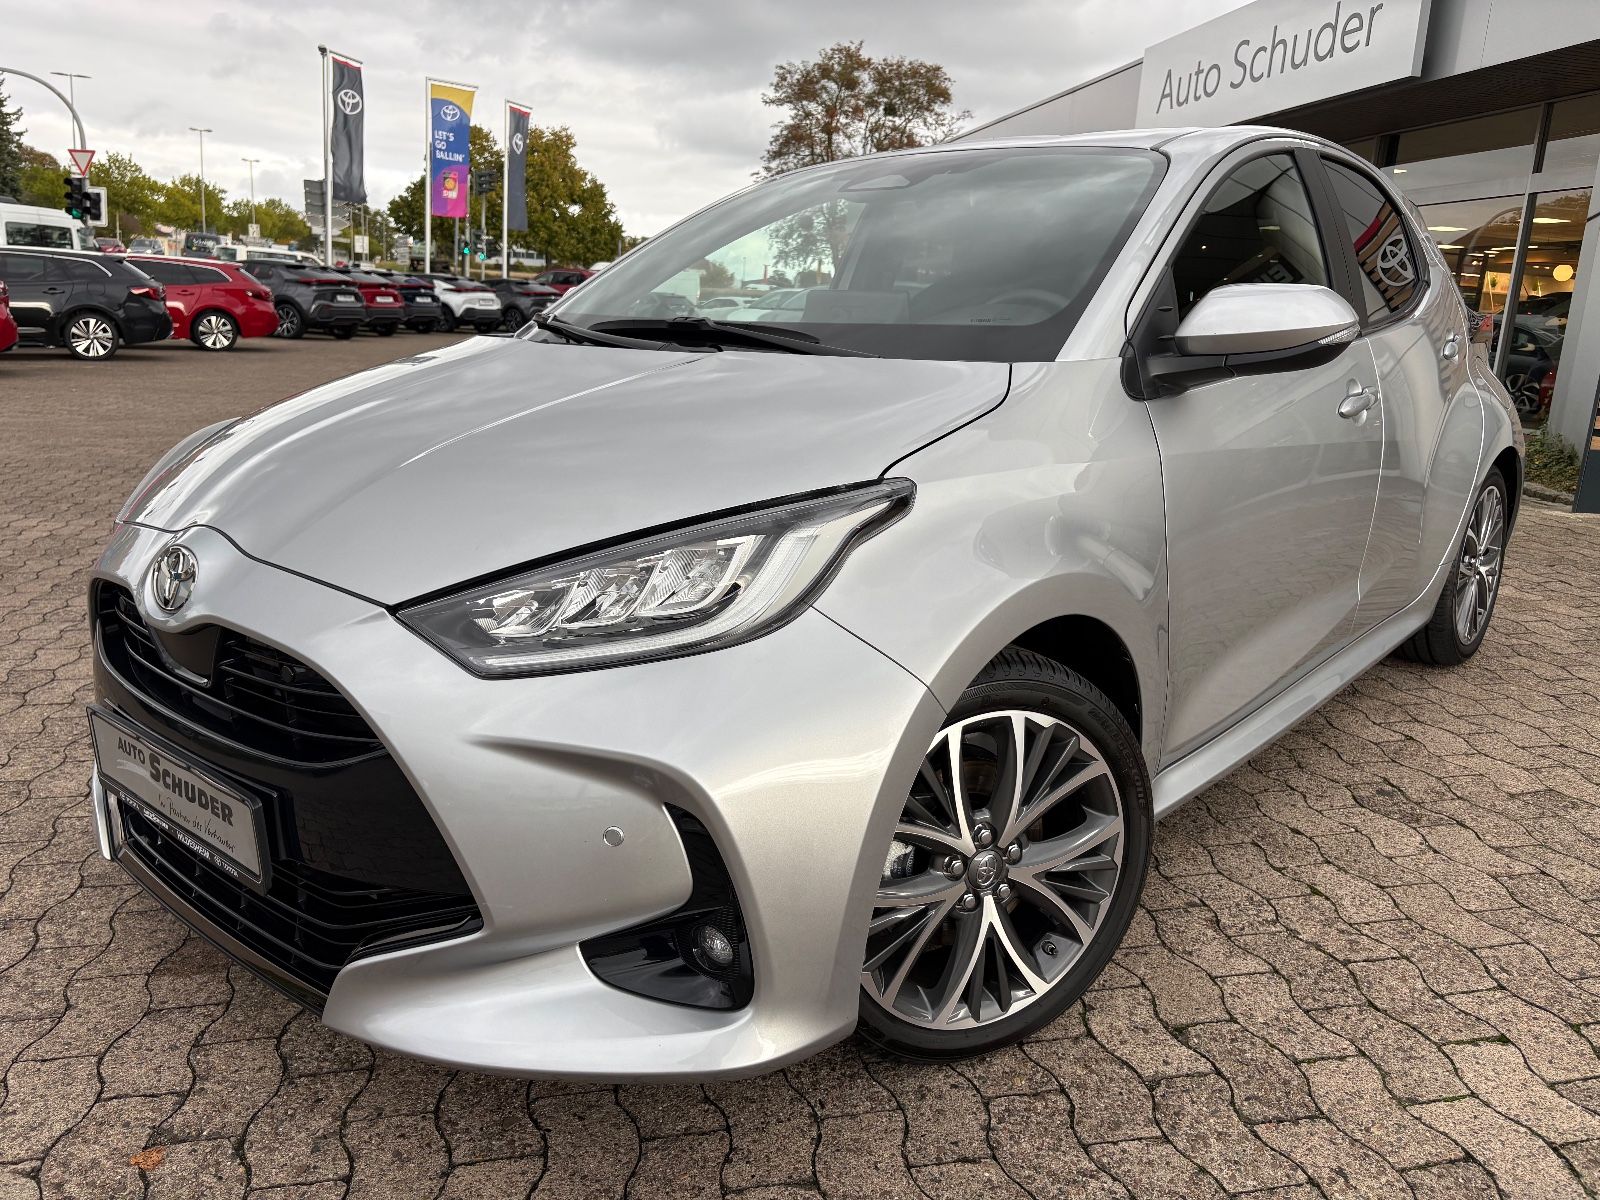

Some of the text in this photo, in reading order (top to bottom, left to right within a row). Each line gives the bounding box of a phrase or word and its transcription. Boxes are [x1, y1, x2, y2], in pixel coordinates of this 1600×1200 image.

[1156, 1, 1385, 114] Auto Schuder
[434, 129, 455, 142] LET'S
[434, 140, 447, 150] GO
[118, 736, 146, 765] AUTO
[148, 752, 235, 828] SCHUDER
